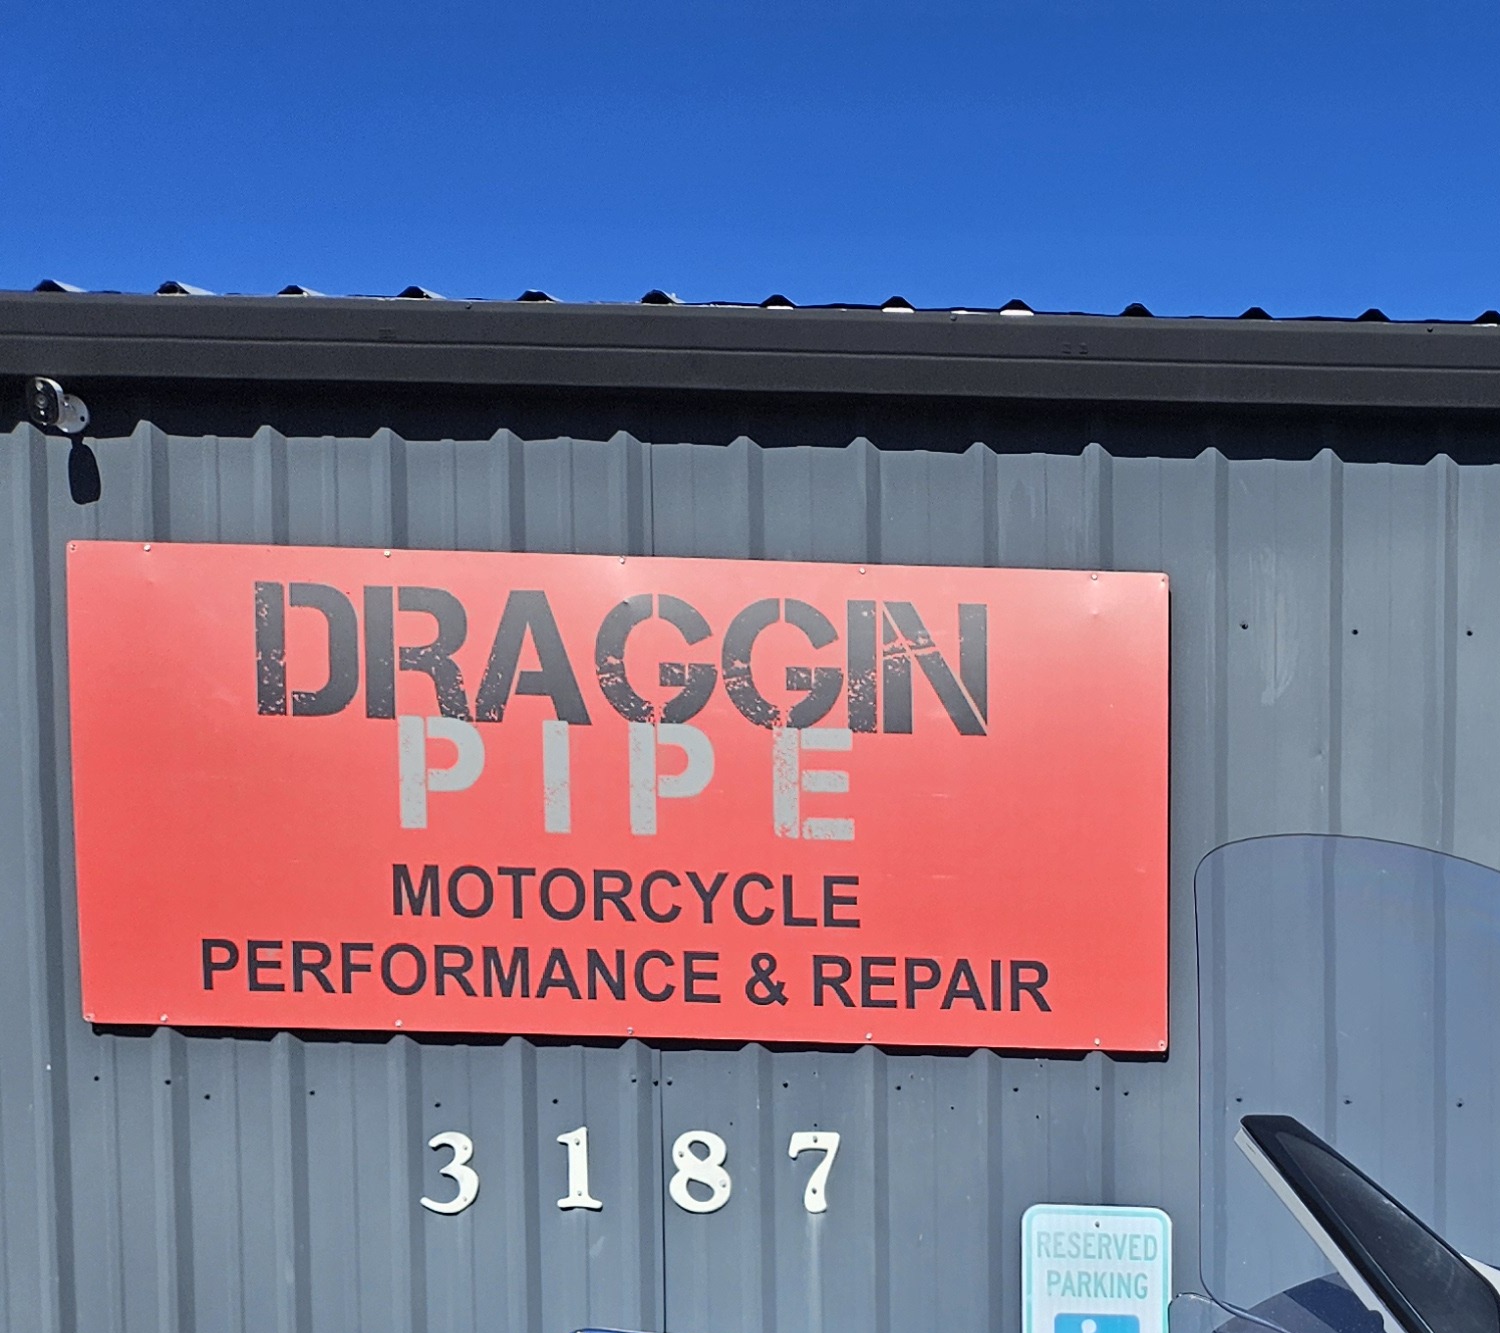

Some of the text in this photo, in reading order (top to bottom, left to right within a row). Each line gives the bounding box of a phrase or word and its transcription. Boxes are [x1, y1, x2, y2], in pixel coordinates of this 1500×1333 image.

[255, 581, 989, 736] DRAGGIN
[399, 715, 856, 840] PIPE
[391, 864, 861, 929] MOTORCYCLE
[201, 938, 1051, 1013] PERFORMANCE & REPAIR
[1036, 1231, 1158, 1261] RESERVED
[1047, 1270, 1149, 1299] PARKING
